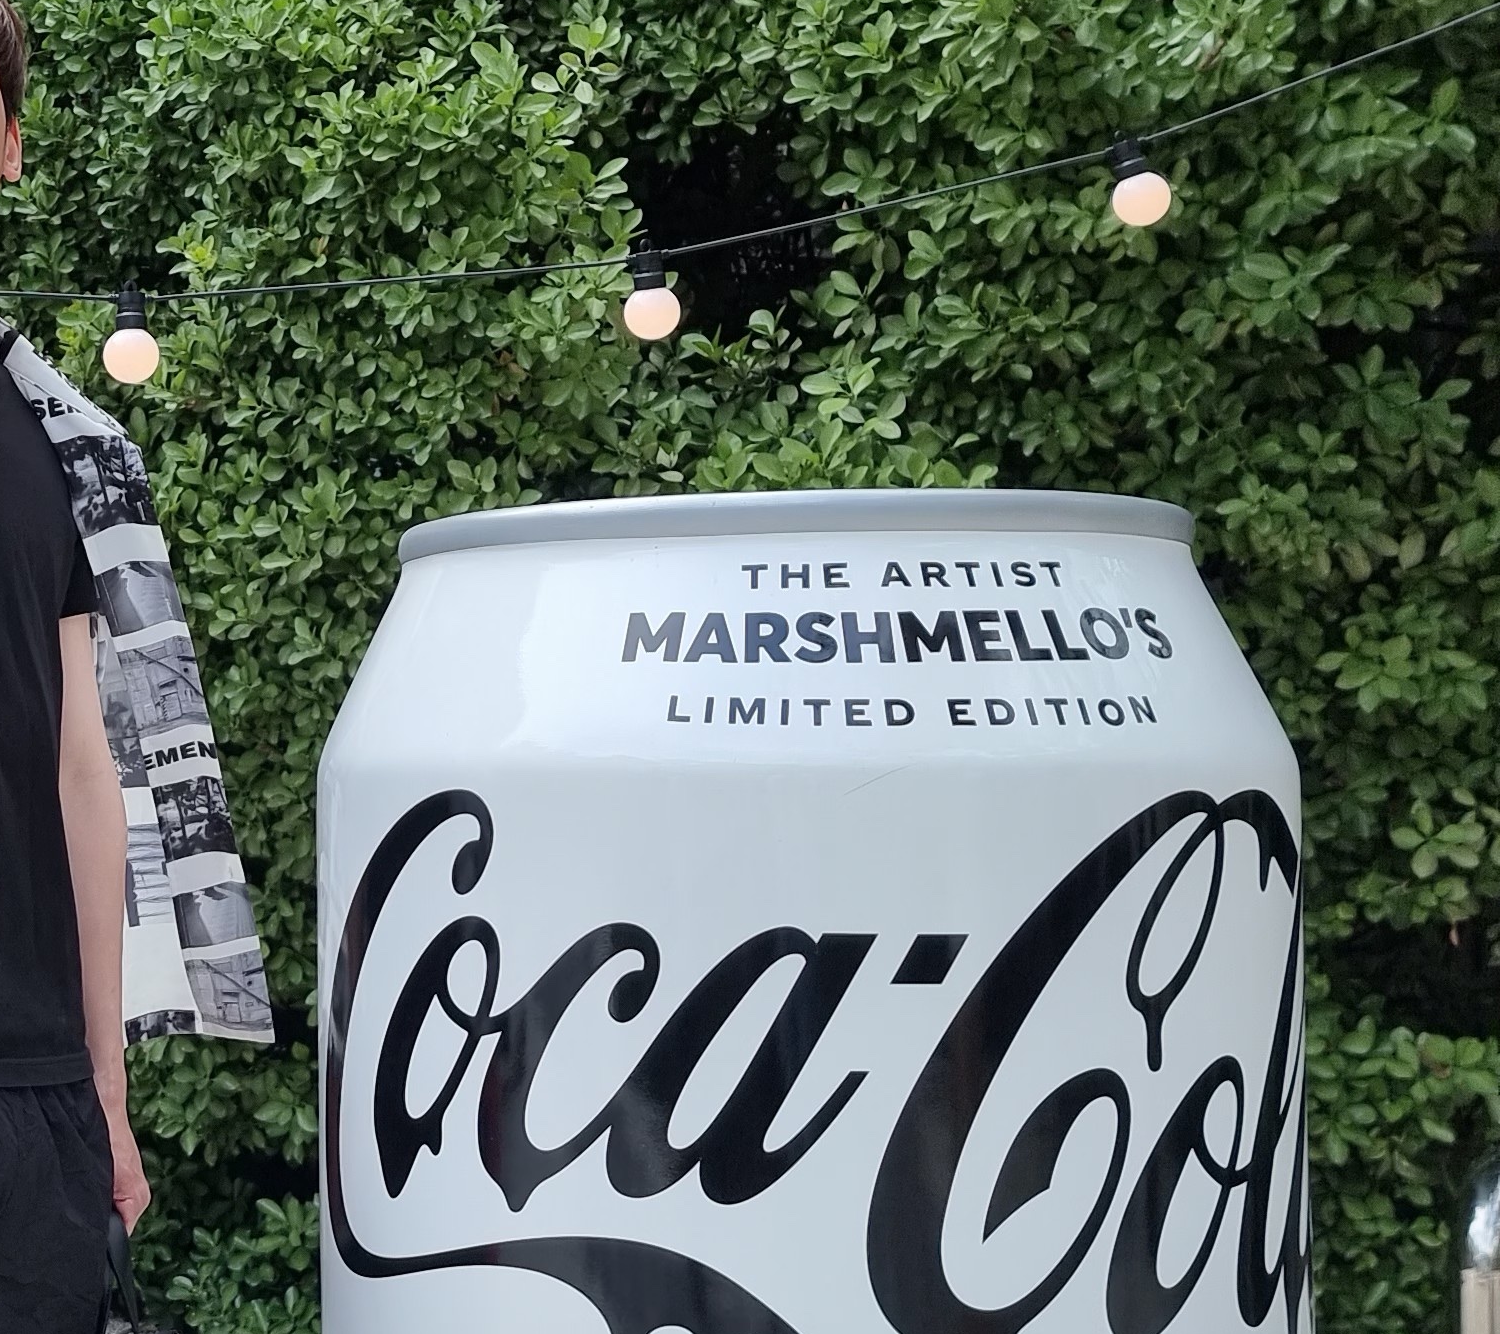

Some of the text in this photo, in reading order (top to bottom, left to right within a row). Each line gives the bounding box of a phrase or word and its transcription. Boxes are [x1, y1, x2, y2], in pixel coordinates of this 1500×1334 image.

[741, 561, 1064, 589] THE ARTIST
[621, 606, 1174, 664] MARSHMELLO'S
[667, 694, 1159, 727] LIMITED EDITION
